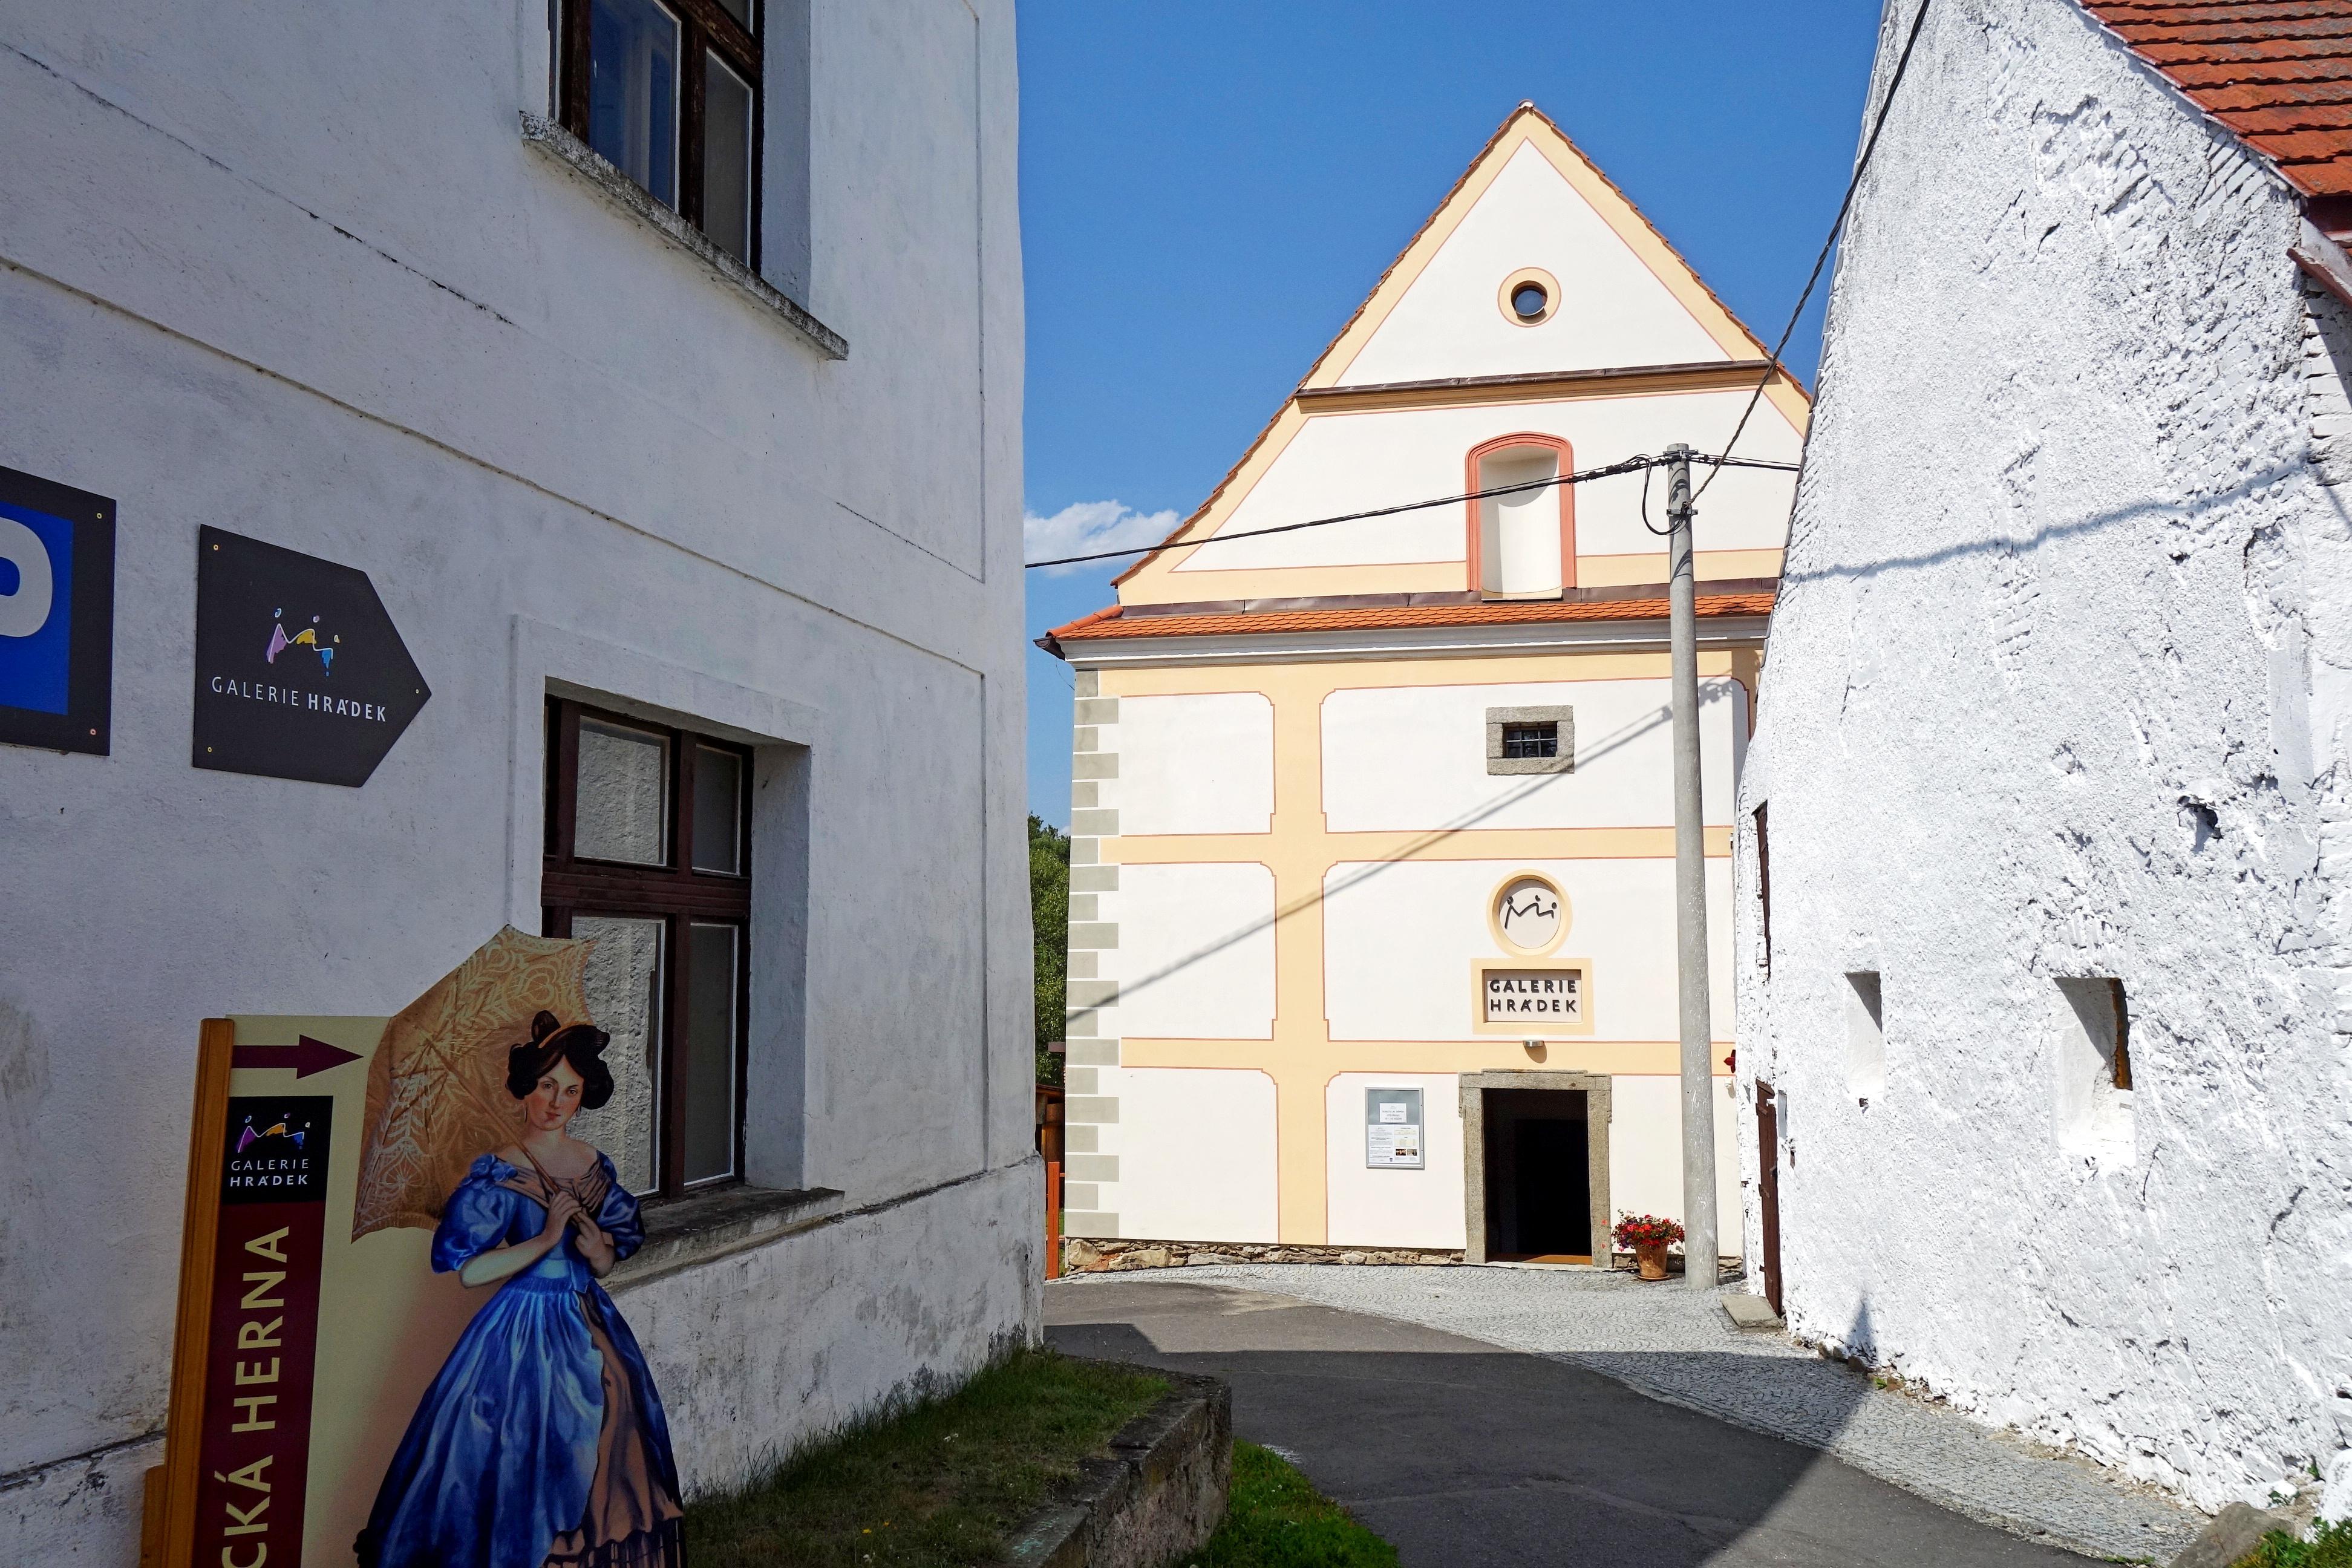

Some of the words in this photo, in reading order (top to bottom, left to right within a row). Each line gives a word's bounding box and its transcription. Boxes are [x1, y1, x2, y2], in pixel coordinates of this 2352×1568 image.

[212, 676, 299, 706] GALERIE
[308, 693, 386, 722] HRÁDEK
[1490, 979, 1576, 993] GALERIE
[1491, 999, 1576, 1013] HRÁDEK
[231, 1159, 309, 1171] GALERIE
[230, 1174, 308, 1187] HRÁDEK
[232, 1226, 289, 1432] HERNA
